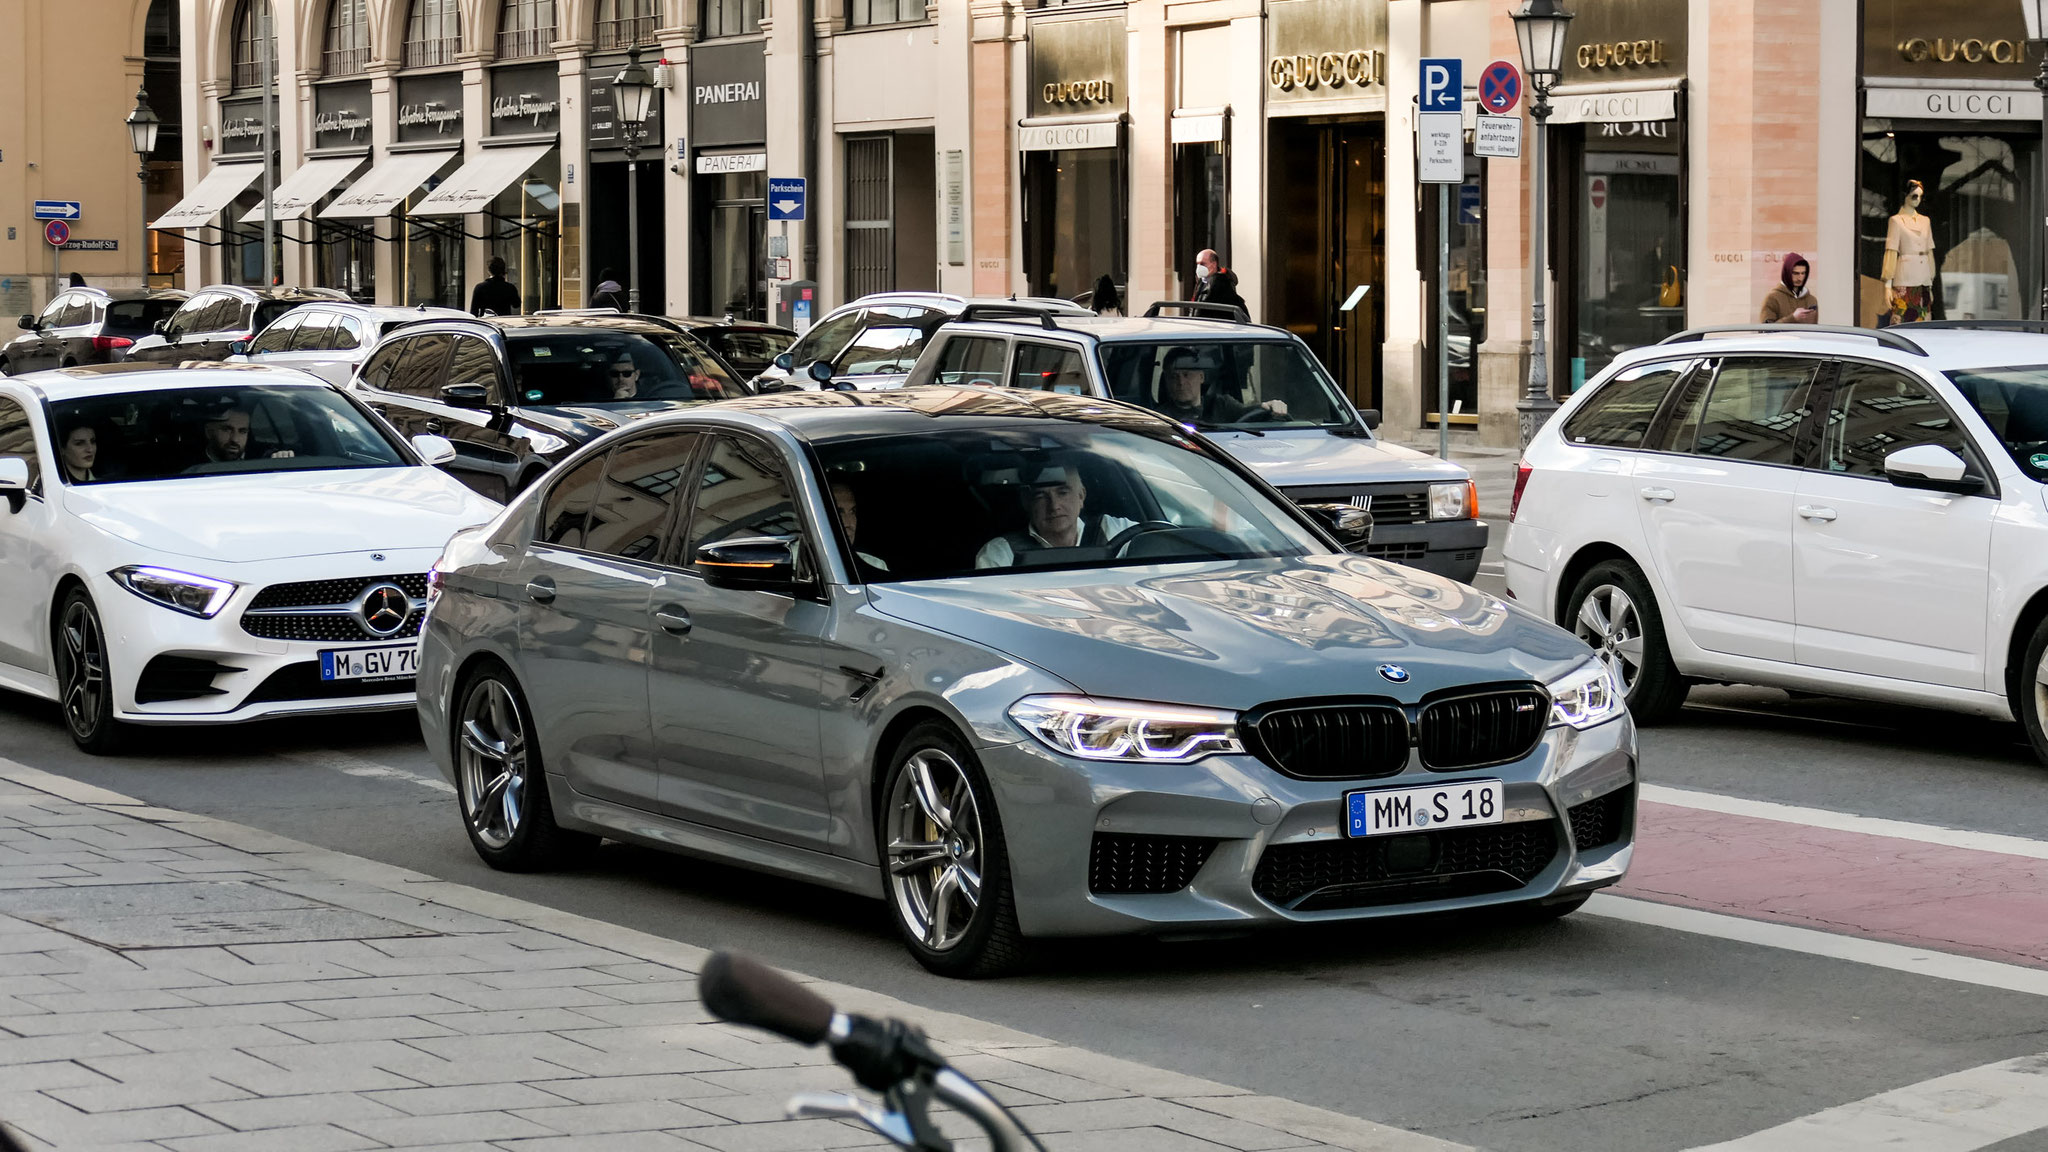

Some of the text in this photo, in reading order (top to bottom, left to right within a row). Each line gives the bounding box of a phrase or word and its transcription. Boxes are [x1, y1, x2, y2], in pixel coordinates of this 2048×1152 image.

[1577, 40, 1660, 68] GUCCI
[1903, 38, 2025, 63] GUCCI
[1270, 50, 1377, 89] GUCCI
[695, 81, 760, 105] PANERAI
[1043, 80, 1106, 103] GUCCI
[1426, 65, 1450, 106] P
[1580, 97, 1639, 117] GUCCI
[1927, 94, 2012, 114] GUCCI
[1045, 128, 1089, 145] GUCCI
[704, 155, 757, 171] PANERAI
[770, 181, 803, 193] Parkschein
[66, 240, 116, 250] rzog-Rudolf-Str.
[1714, 254, 1743, 263] GUCCI
[325, 668, 331, 676] D
[336, 654, 350, 676] M
[365, 651, 392, 674] GV
[1374, 787, 1494, 829] MM S 18
[1354, 818, 1362, 829] D
